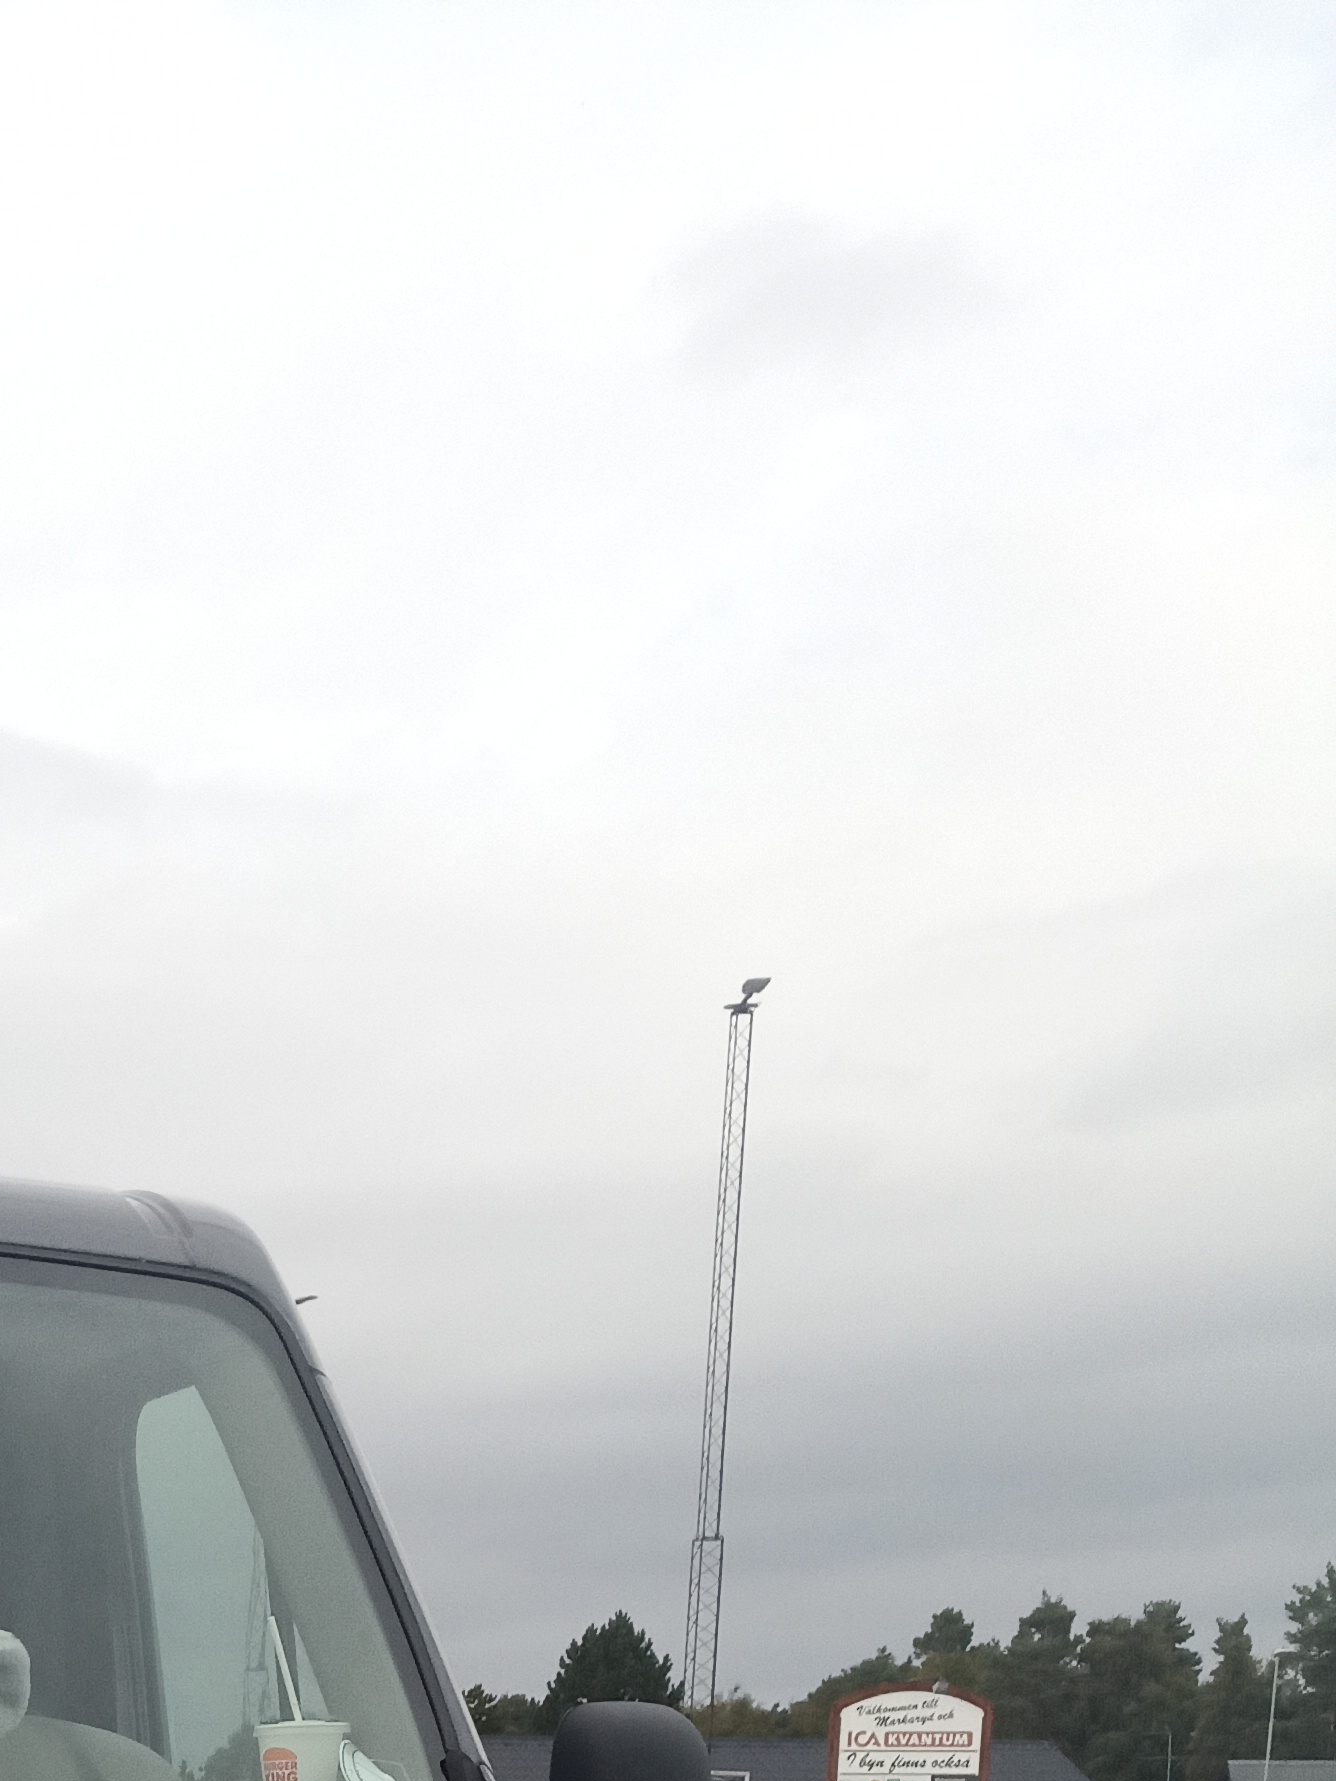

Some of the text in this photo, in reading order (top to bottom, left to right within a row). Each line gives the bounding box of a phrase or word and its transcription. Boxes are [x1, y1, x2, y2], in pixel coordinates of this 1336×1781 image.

[857, 1697, 939, 1716] Välkommen till
[874, 1709, 954, 1727] Markaryd och
[847, 1731, 969, 1748] ICA KVANTUM
[859, 1752, 885, 1771] byn
[889, 1754, 927, 1774] finns
